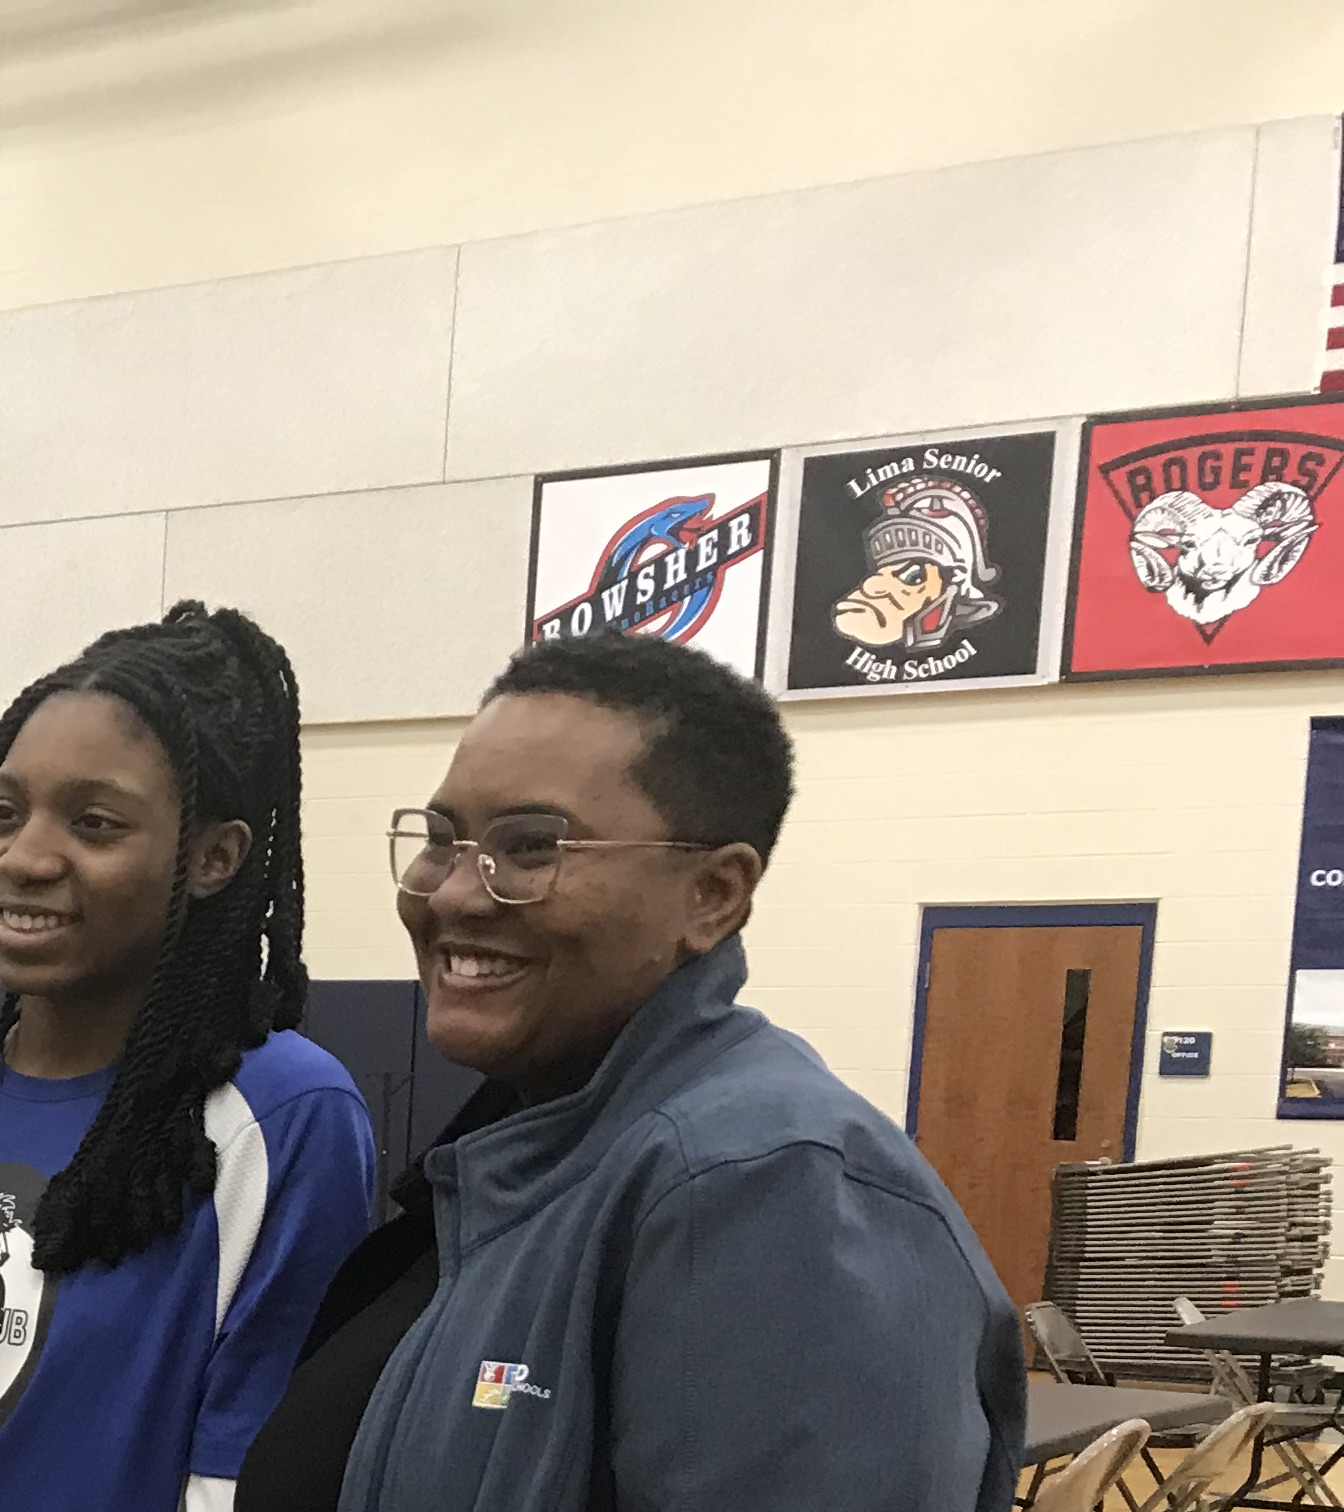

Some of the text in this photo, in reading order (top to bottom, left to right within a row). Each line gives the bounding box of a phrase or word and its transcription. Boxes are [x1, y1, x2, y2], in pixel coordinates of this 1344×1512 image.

[846, 448, 1002, 499] Lima Senior
[1126, 447, 1325, 507] ROGERS
[845, 638, 978, 682] High School
[1311, 869, 1344, 887] CO
